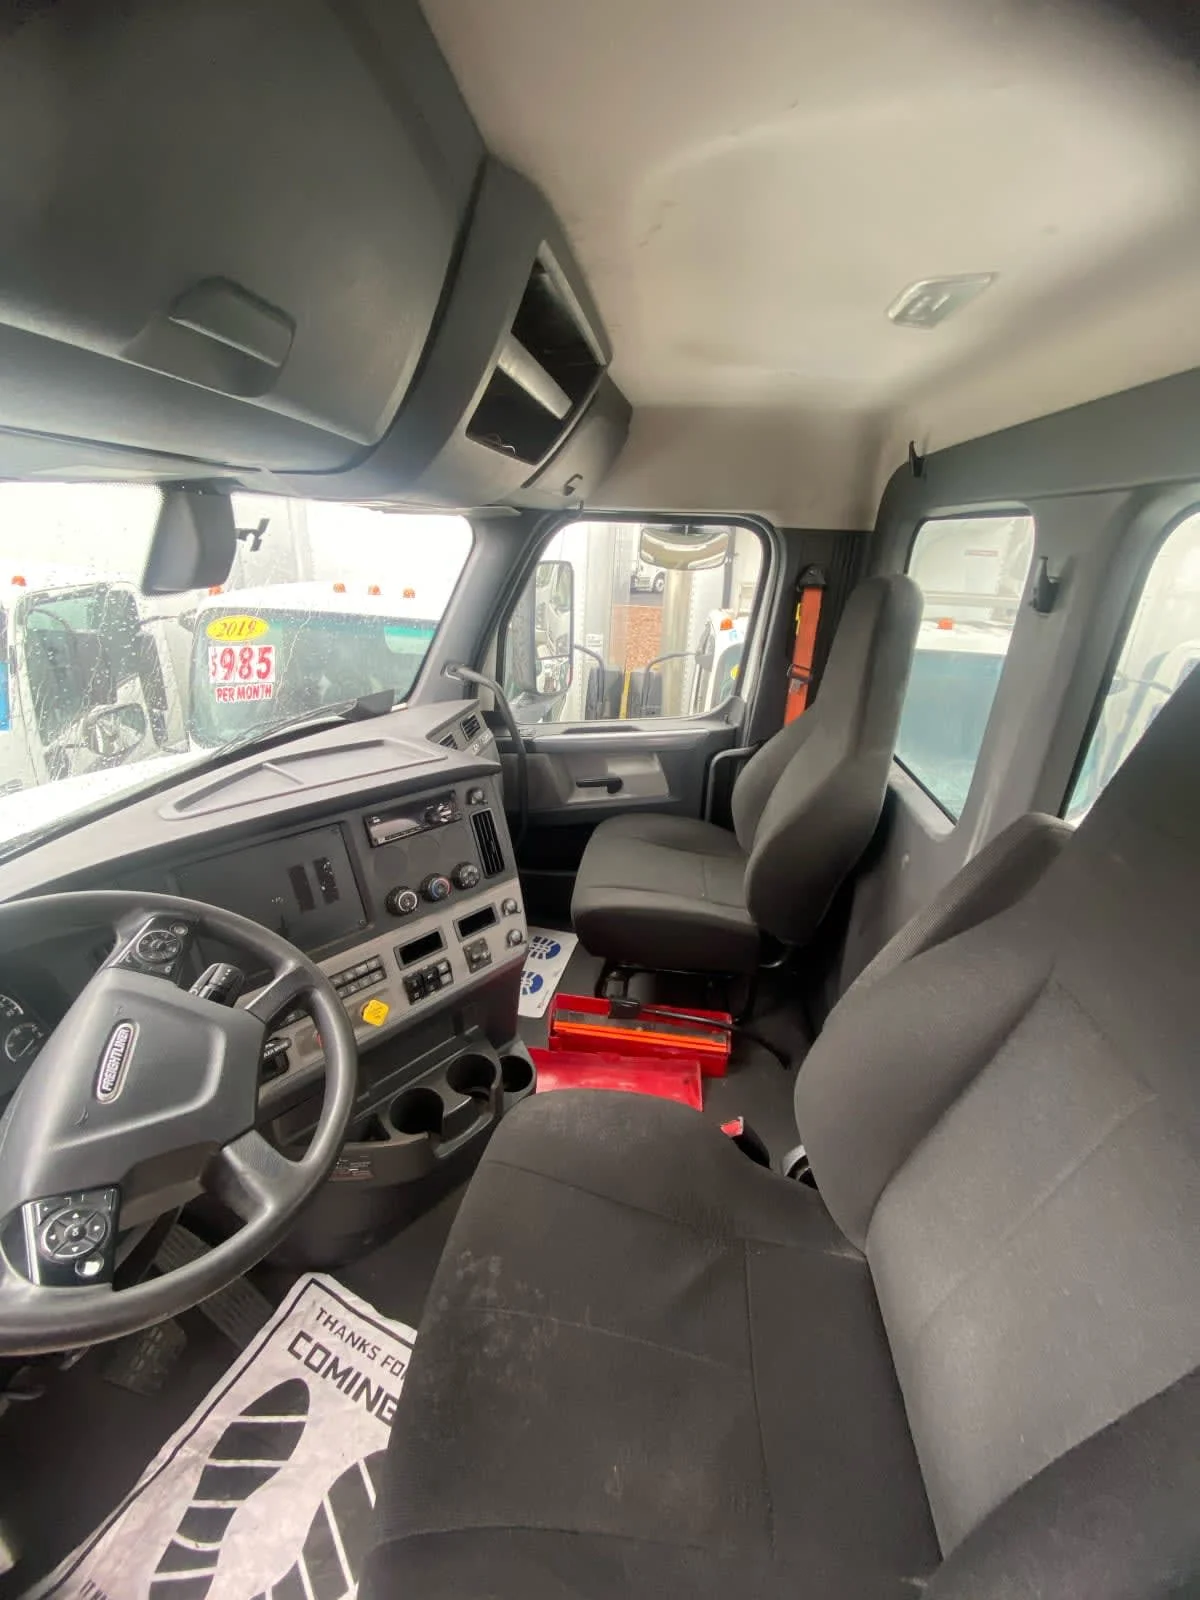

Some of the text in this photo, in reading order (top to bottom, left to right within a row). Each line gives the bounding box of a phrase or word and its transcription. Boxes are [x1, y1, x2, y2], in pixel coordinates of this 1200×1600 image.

[215, 620, 257, 638] 2019
[216, 684, 272, 702] PER MONTH
[101, 1028, 131, 1092] FREIGHTLINER
[316, 1307, 406, 1380] THANKS FO
